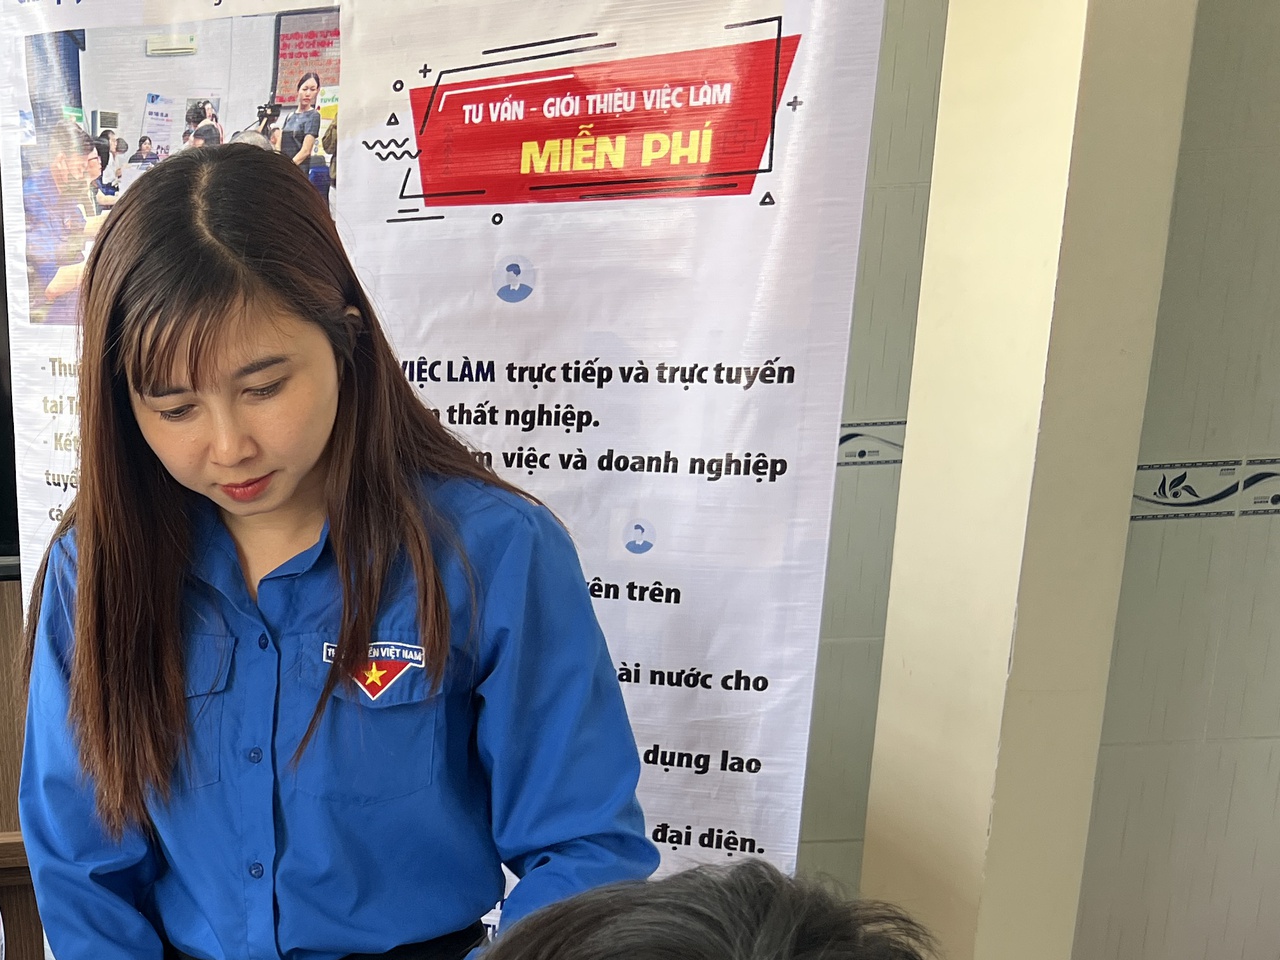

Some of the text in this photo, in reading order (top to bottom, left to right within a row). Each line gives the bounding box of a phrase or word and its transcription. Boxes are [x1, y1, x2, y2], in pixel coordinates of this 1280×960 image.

[462, 103, 484, 124] TƯ
[489, 94, 525, 121] VẤN
[543, 95, 580, 119] GIỚI
[586, 89, 635, 119] THIỆU
[642, 83, 684, 114] VIỆC
[689, 82, 732, 107] LÀM
[520, 121, 712, 175] MIỄN PHÍ
[446, 356, 495, 383] LÀM
[506, 361, 557, 389] trực
[561, 358, 613, 388] tiếp
[619, 360, 649, 384] và
[655, 361, 708, 391] trực
[713, 356, 795, 391] tuyến
[43, 395, 64, 420] tại
[446, 401, 499, 426] thất
[504, 404, 600, 434] nghiệp.
[45, 468, 79, 492] tuyế
[502, 449, 551, 476] việc
[559, 448, 587, 471] và
[597, 449, 679, 474] doanh
[688, 452, 789, 482] nghiệp
[48, 504, 64, 522] cá
[626, 580, 681, 605] trên
[380, 646, 401, 659] VIỆT
[402, 650, 422, 661] NAM
[649, 667, 713, 690] nước
[721, 670, 769, 692] cho
[643, 744, 762, 775] dụng lao
[652, 823, 765, 857] đại diện.
